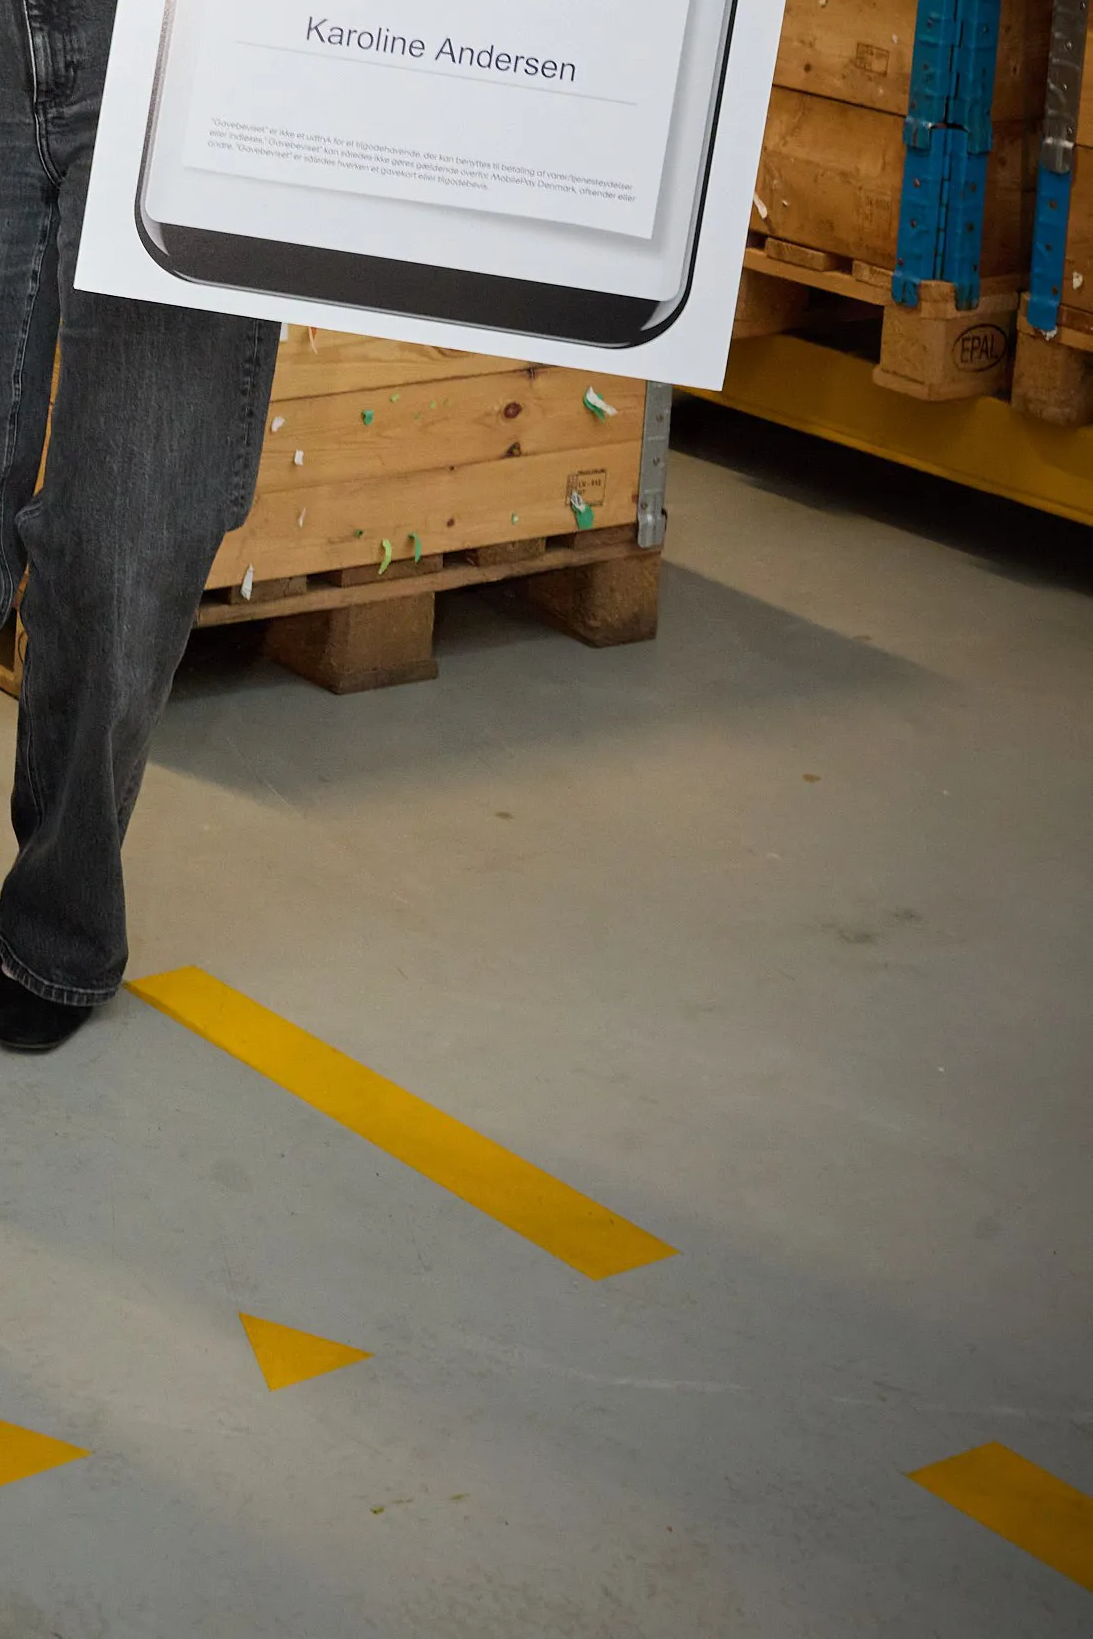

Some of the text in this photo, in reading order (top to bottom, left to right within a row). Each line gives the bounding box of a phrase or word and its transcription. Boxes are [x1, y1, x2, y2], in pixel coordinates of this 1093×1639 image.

[306, 16, 577, 82] Karoline Andersen
[960, 333, 999, 363] EPAL
